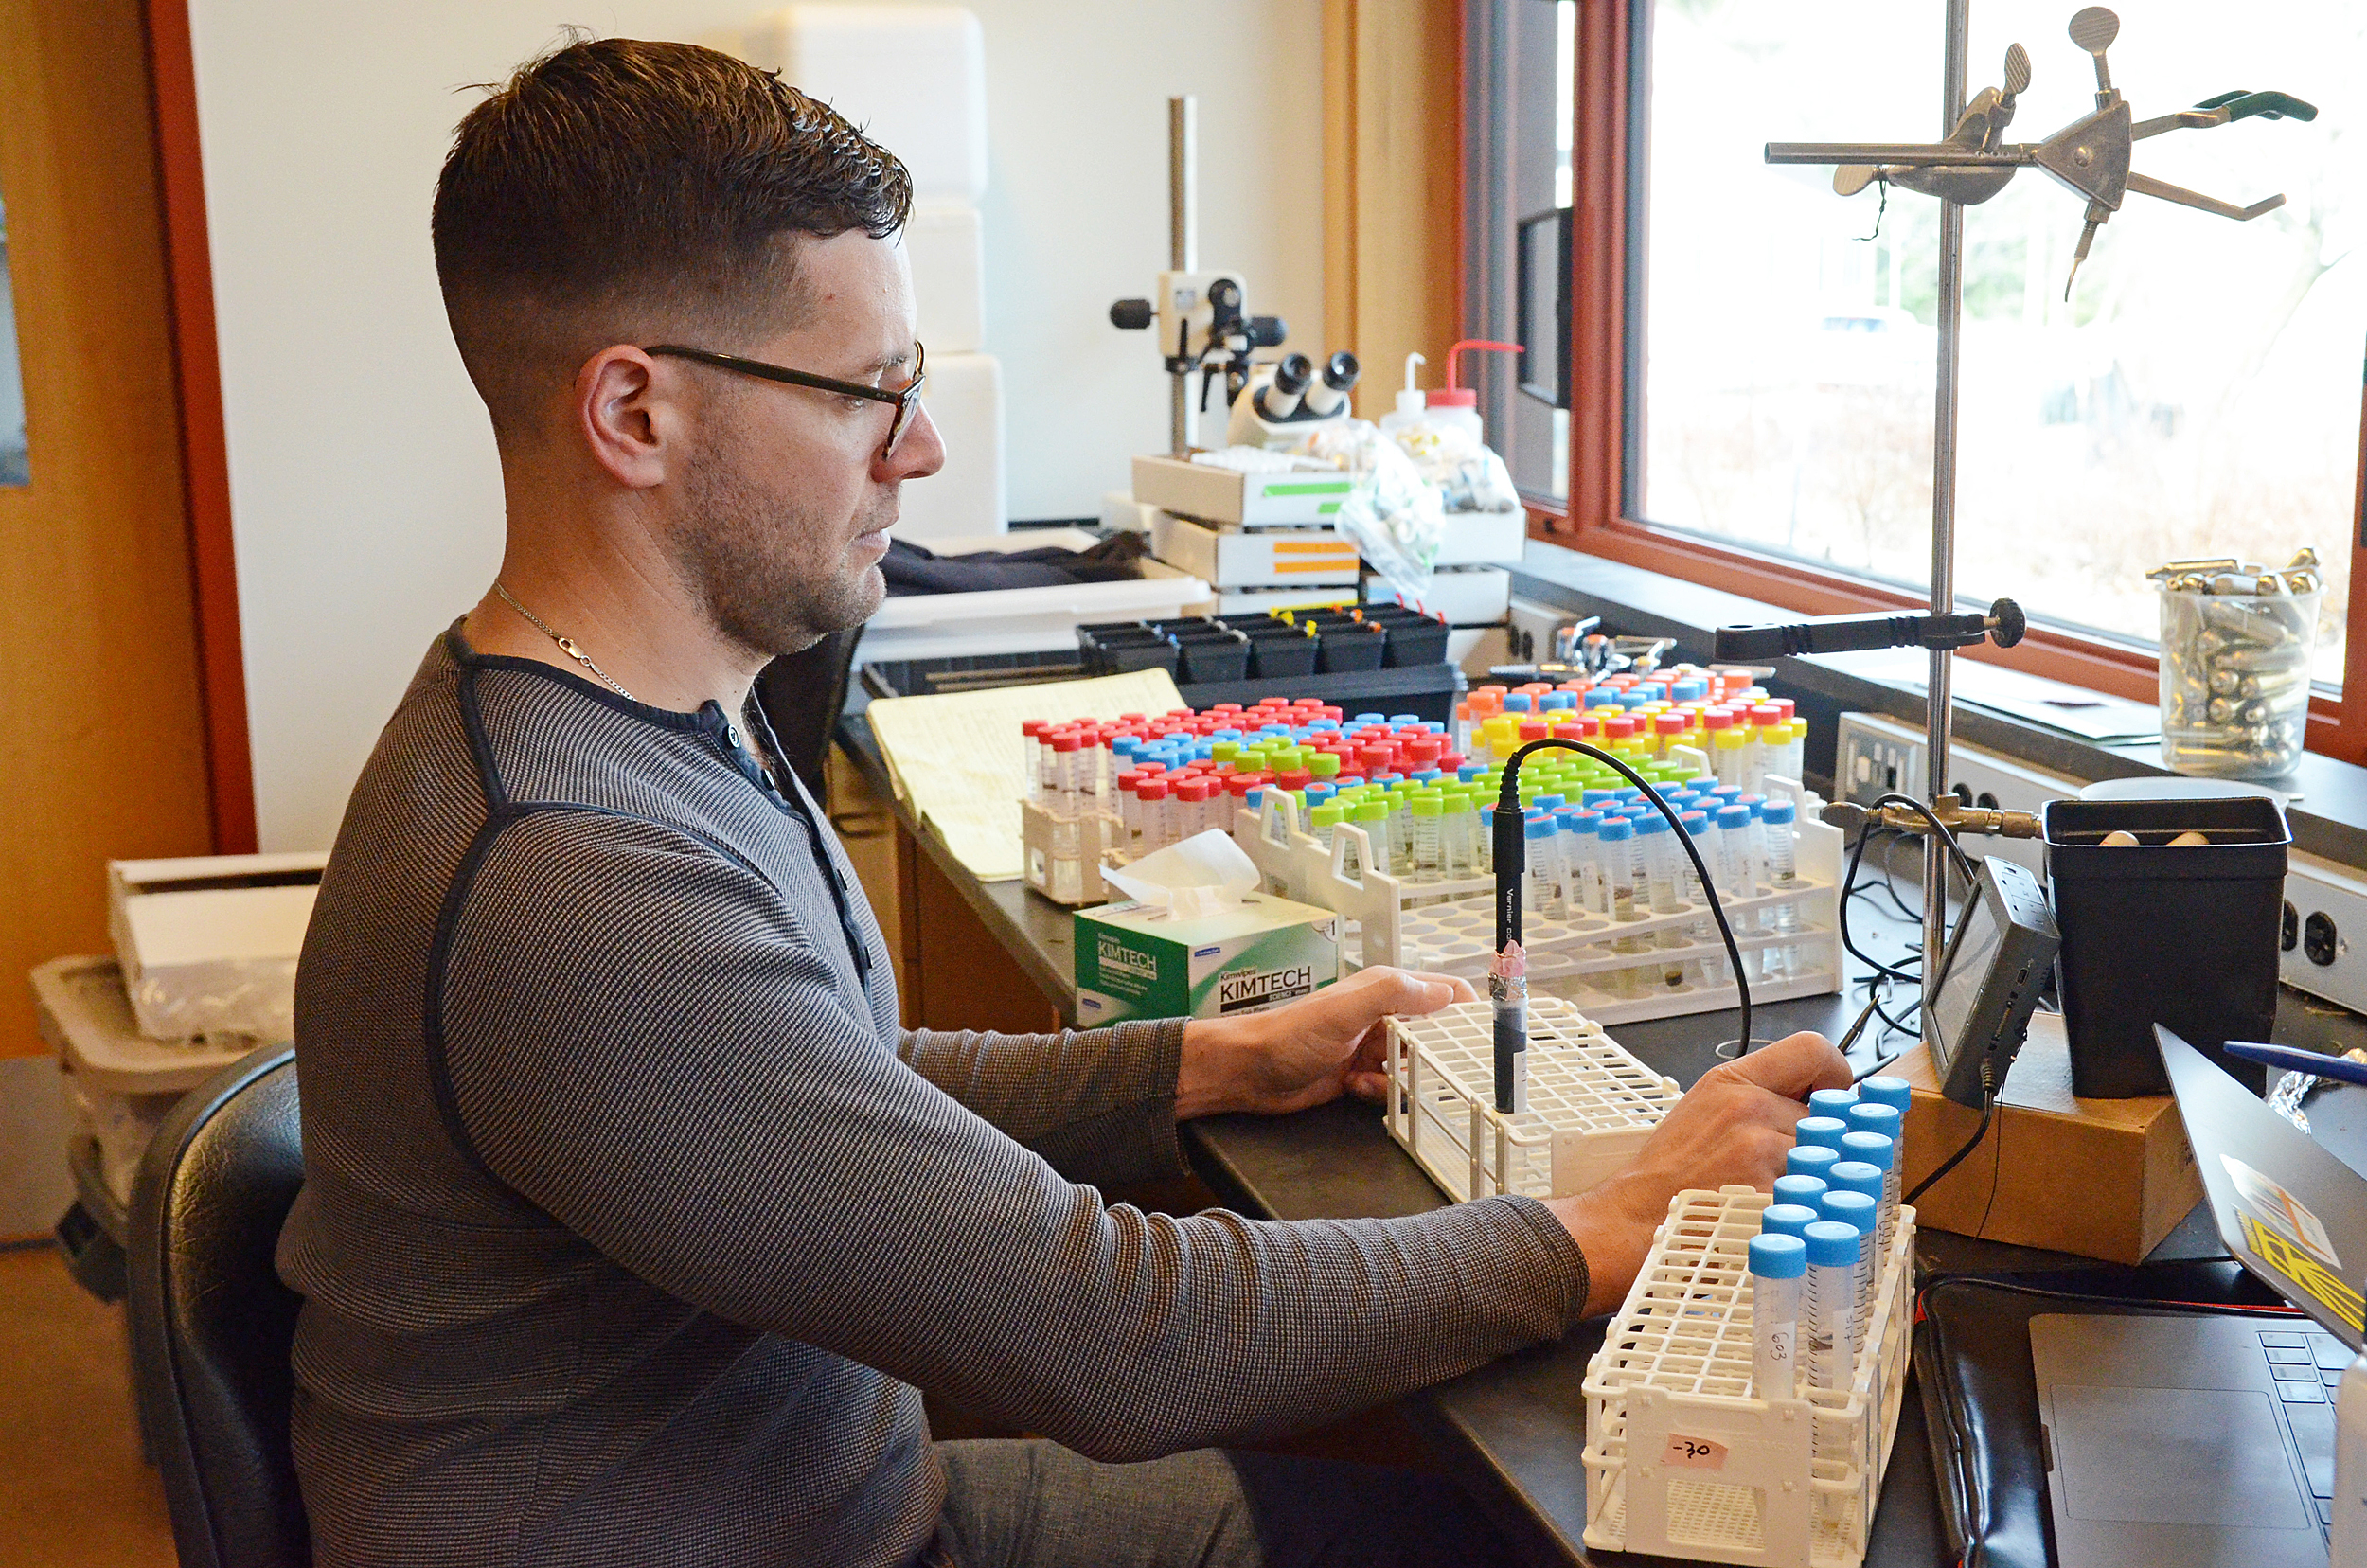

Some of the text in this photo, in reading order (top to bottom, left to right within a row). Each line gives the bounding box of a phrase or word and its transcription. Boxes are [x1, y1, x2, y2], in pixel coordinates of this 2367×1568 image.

[1098, 940, 1157, 971] KIMTECH
[1220, 968, 1256, 982] Kimwipes
[1220, 966, 1311, 1002] KIMTECH
[1770, 1331, 1789, 1362] 603
[1673, 1441, 1710, 1459] -30
